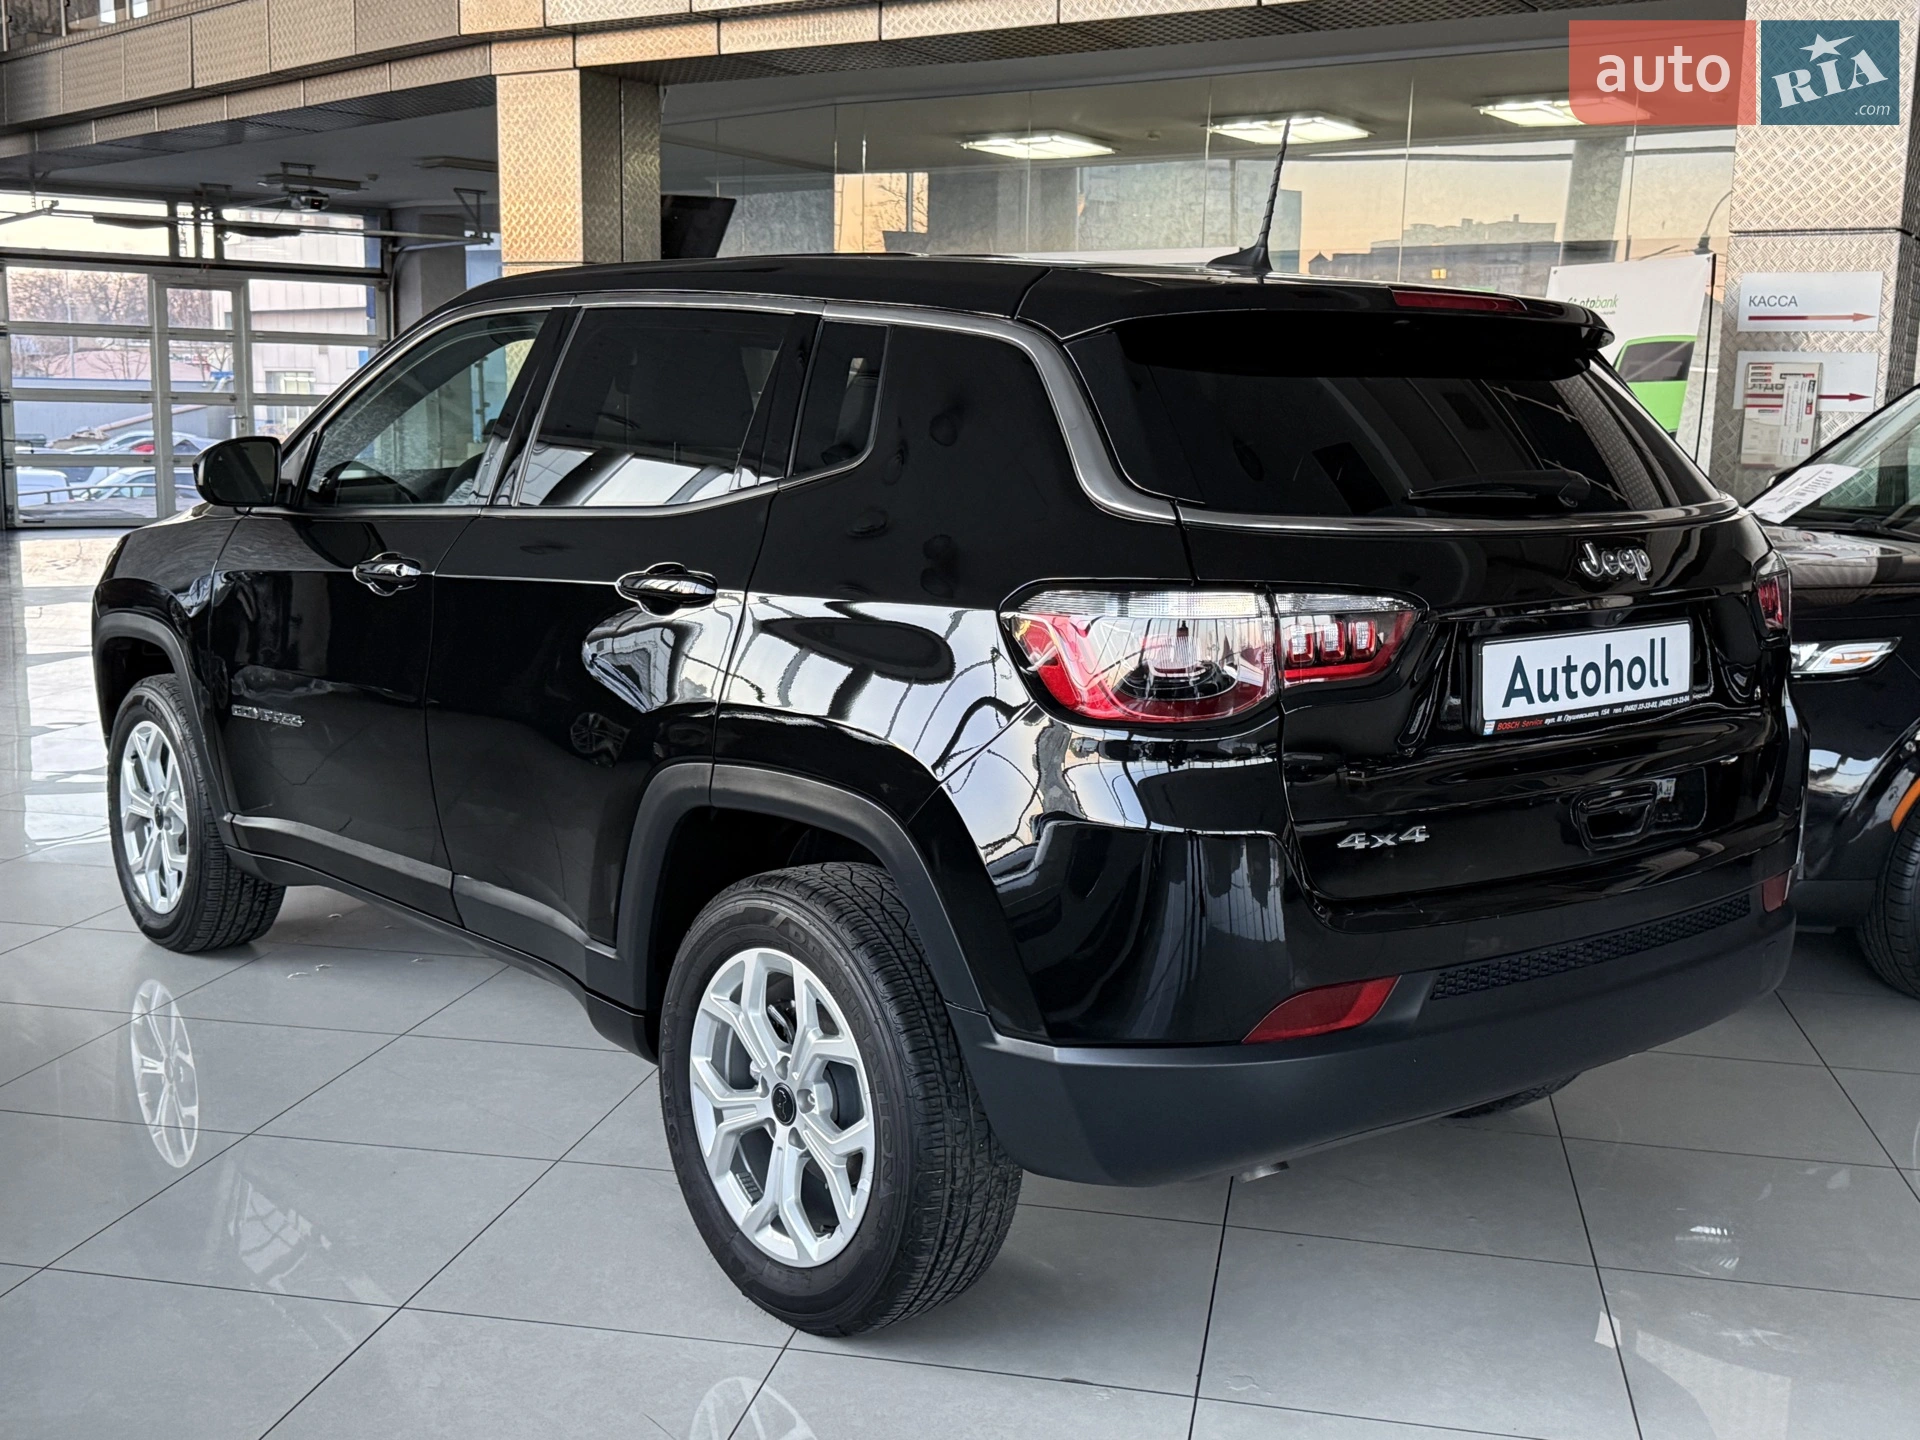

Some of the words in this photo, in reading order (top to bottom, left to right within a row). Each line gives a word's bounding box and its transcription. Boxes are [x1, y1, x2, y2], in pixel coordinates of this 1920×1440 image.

[1748, 295, 1798, 307] КАССА
[1578, 542, 1651, 581] Jeep
[1501, 636, 1669, 708] Autoholl
[1496, 721, 1519, 731] BOSCH
[1521, 718, 1543, 728] Service
[1337, 825, 1430, 850] 4x4
